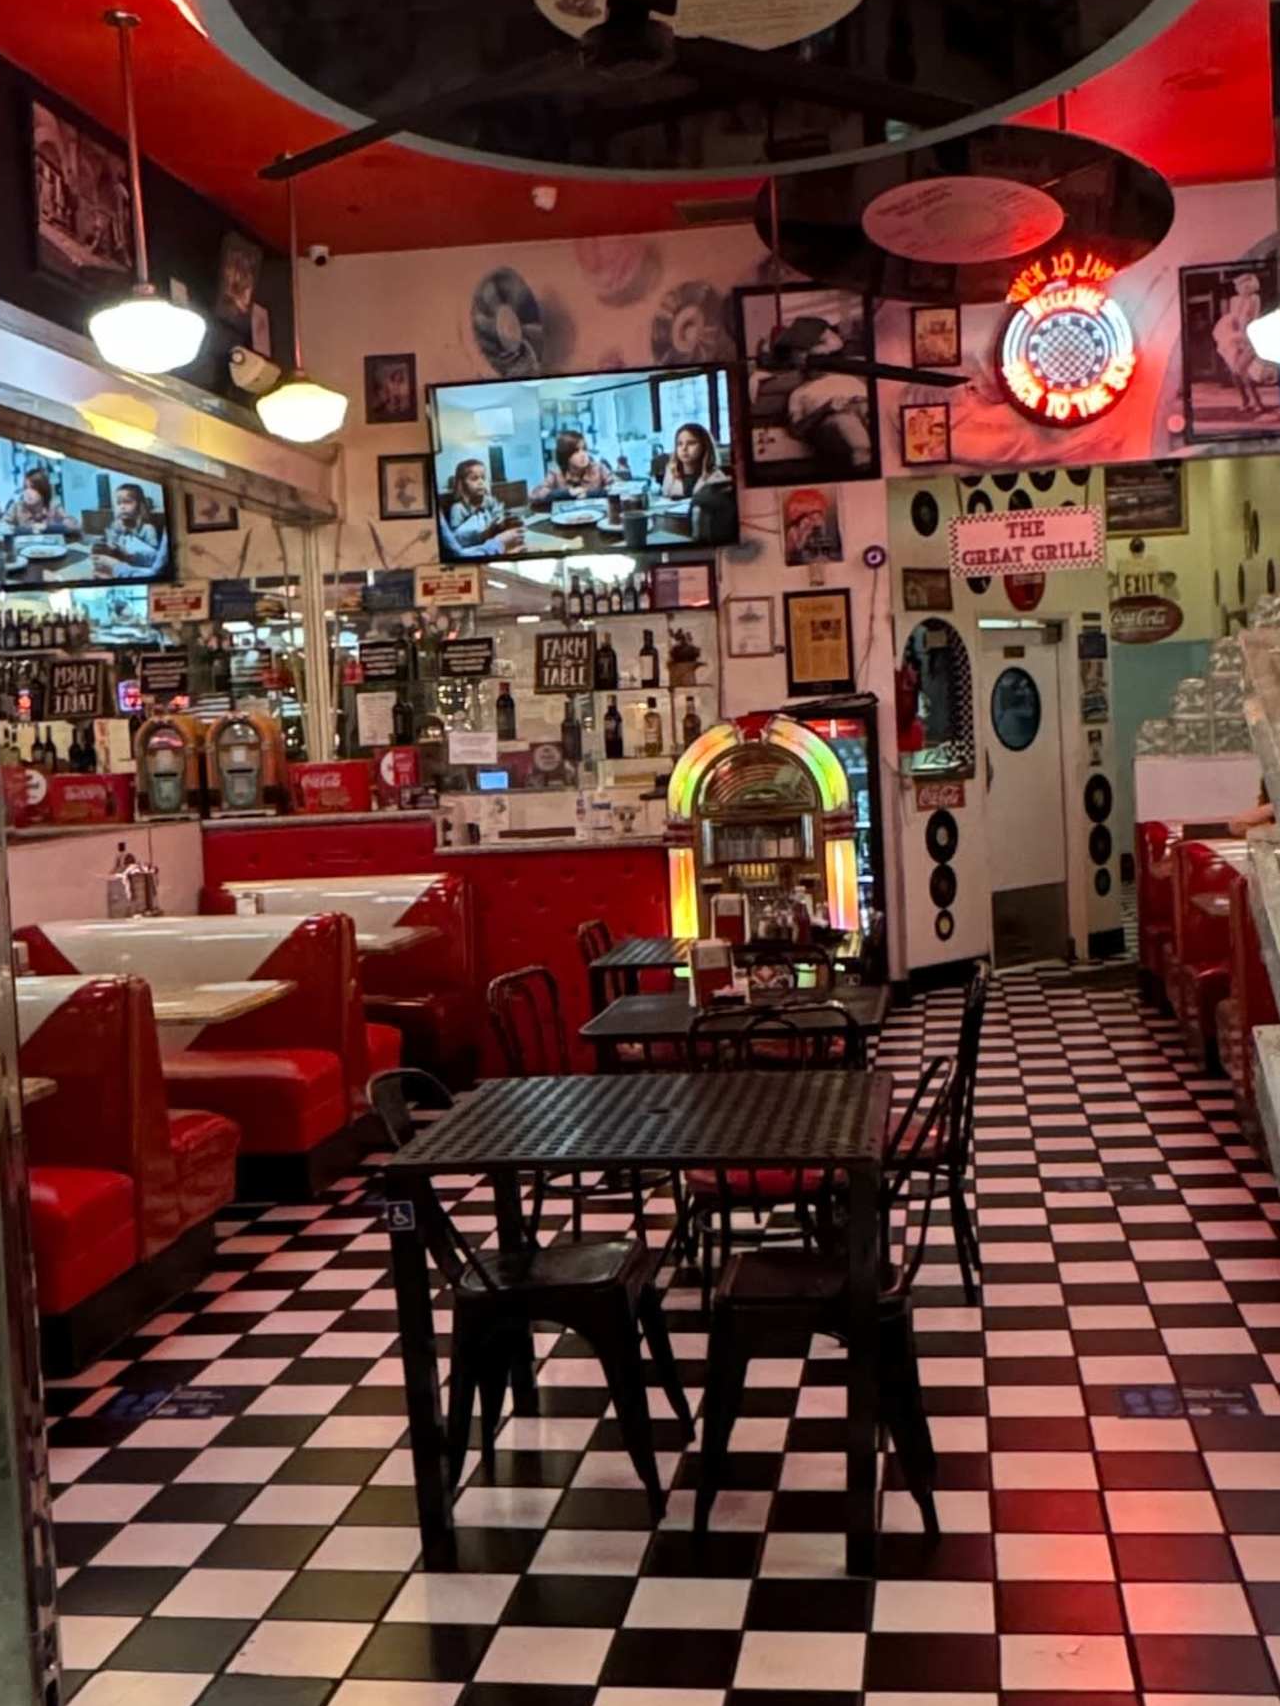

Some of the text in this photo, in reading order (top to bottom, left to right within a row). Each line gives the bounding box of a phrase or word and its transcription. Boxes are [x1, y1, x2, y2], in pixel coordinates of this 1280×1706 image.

[1046, 393, 1070, 419] TO
[1005, 519, 1045, 539] THE
[962, 542, 1092, 566] GREAT GRILL
[1125, 572, 1154, 594] EXIT
[543, 637, 587, 660] FARM
[544, 666, 587, 686] TABLE
